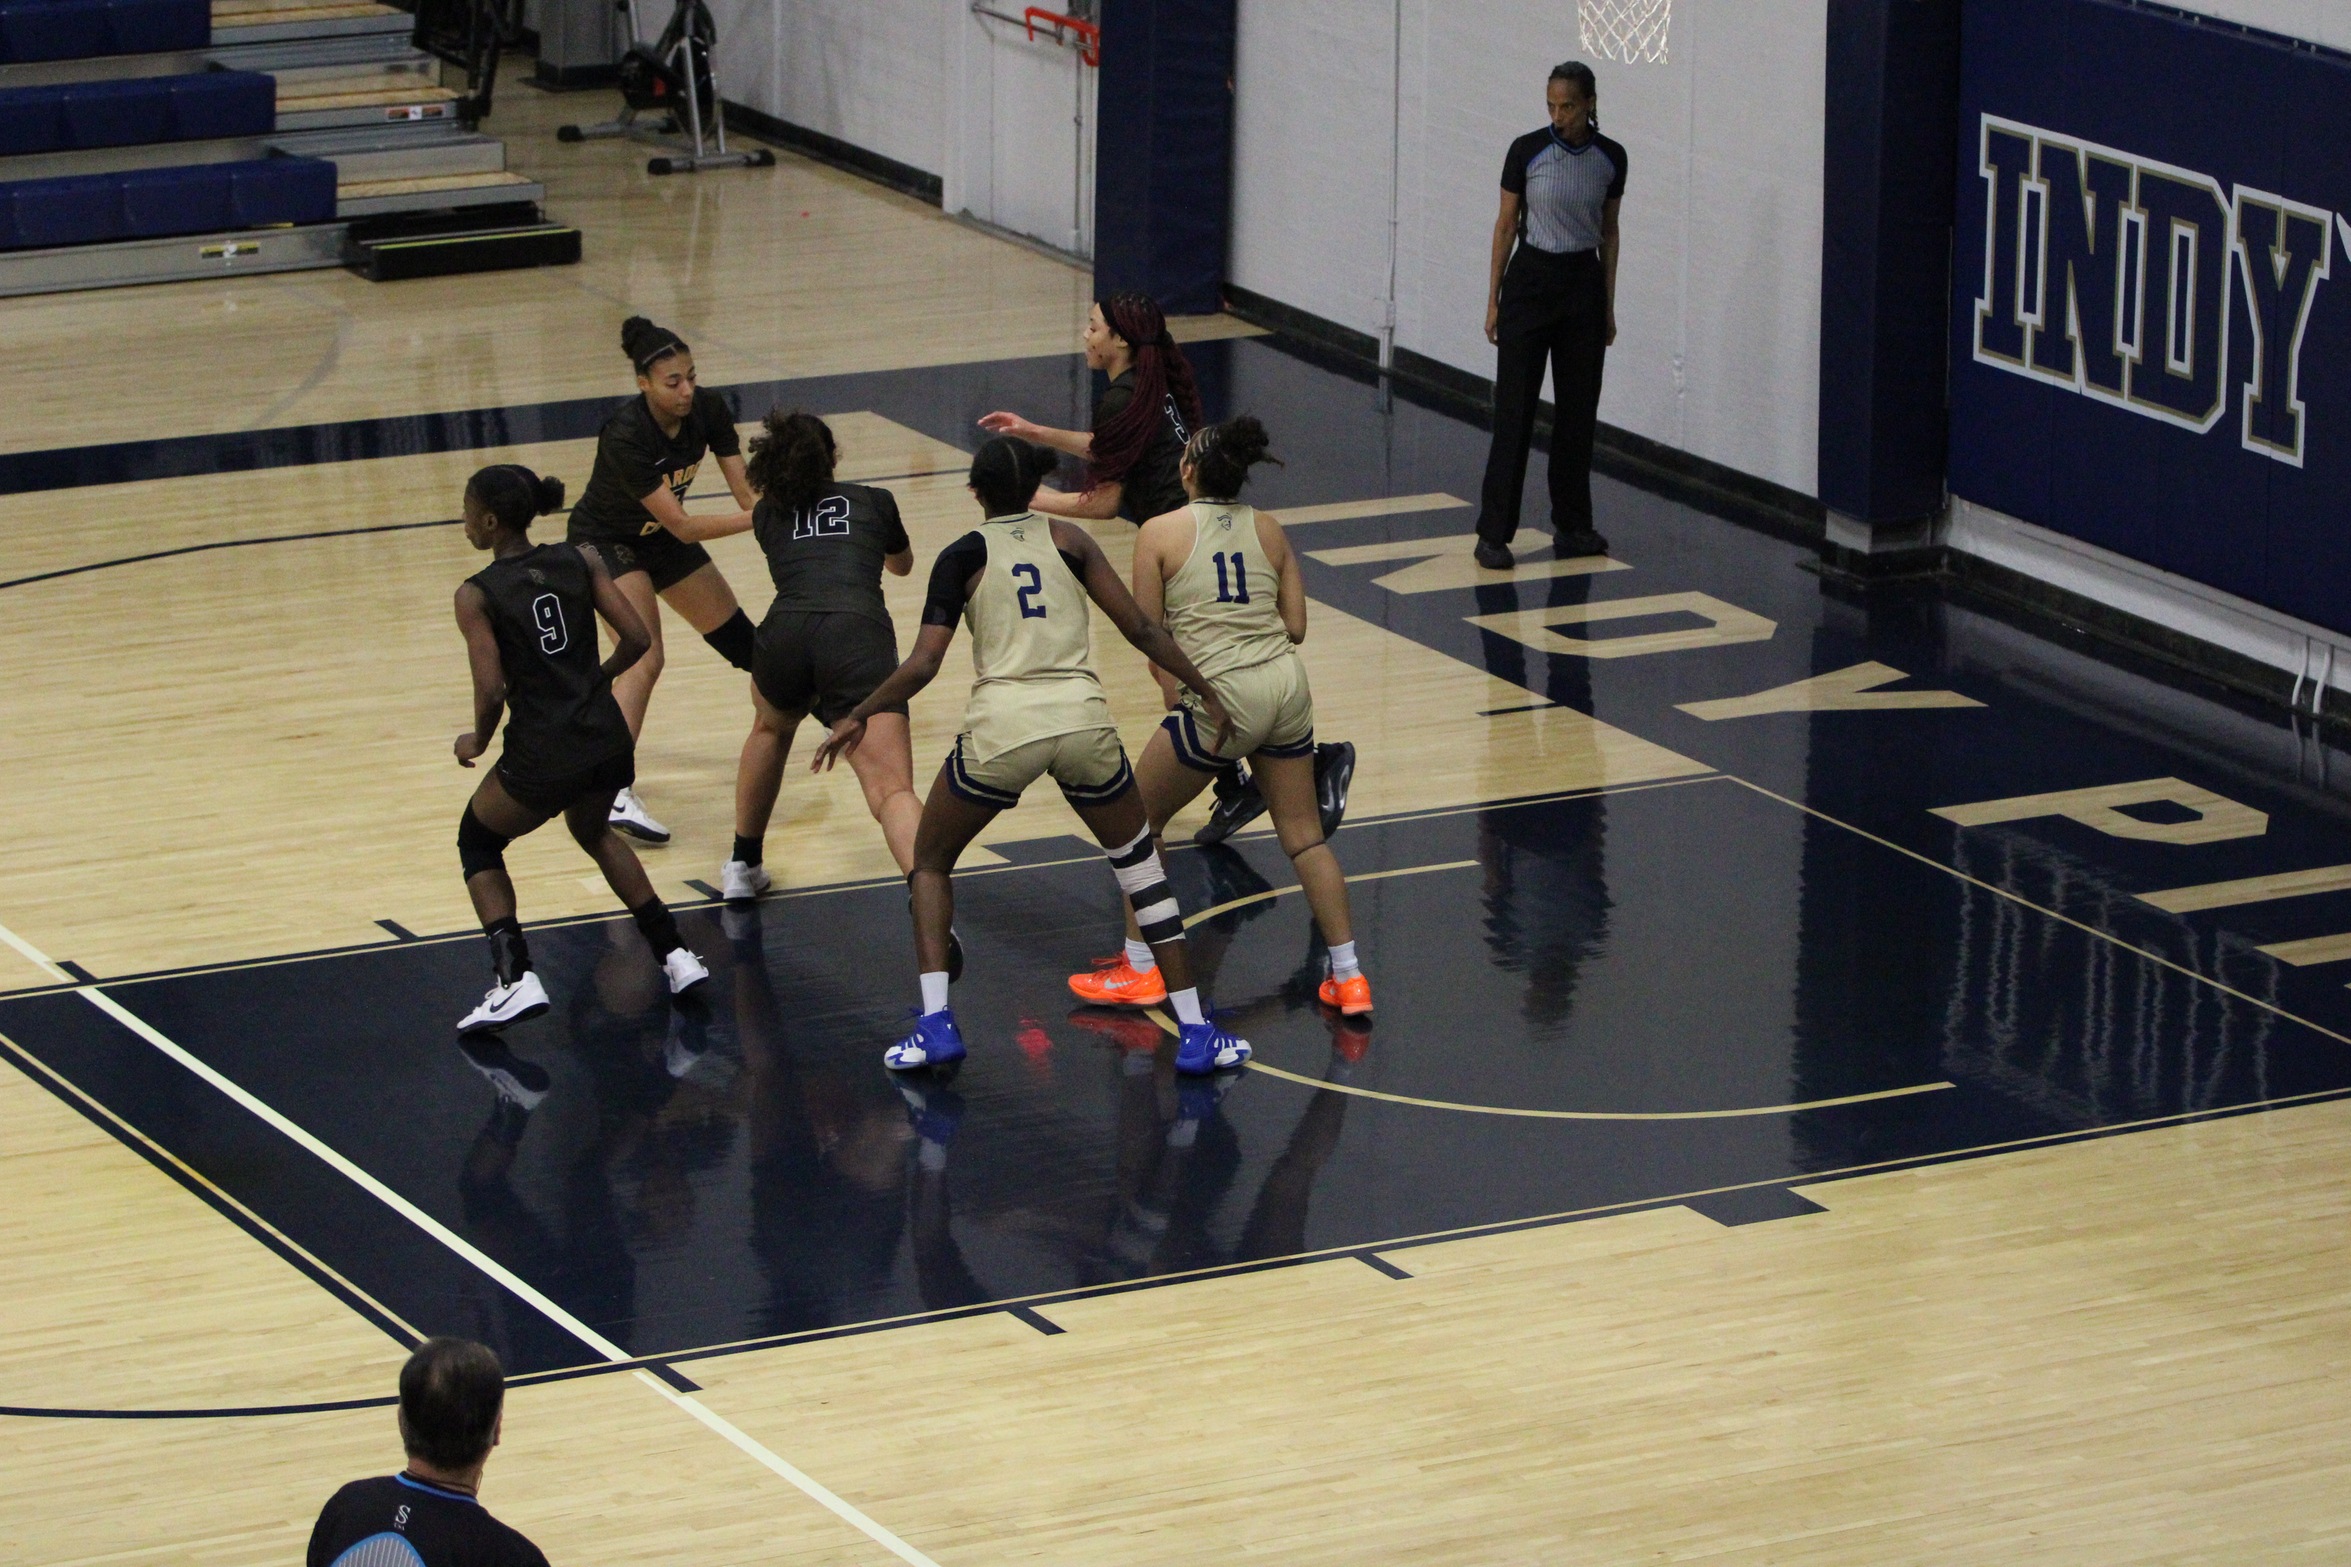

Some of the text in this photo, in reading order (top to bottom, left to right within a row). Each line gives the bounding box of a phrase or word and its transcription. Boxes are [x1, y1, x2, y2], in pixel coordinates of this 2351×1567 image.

[1973, 112, 2333, 470] INDY
[792, 495, 850, 540] 12
[1012, 563, 1047, 619] 2
[1212, 551, 1250, 604] 11
[1262, 491, 1988, 721] INDY
[532, 593, 568, 655] 9
